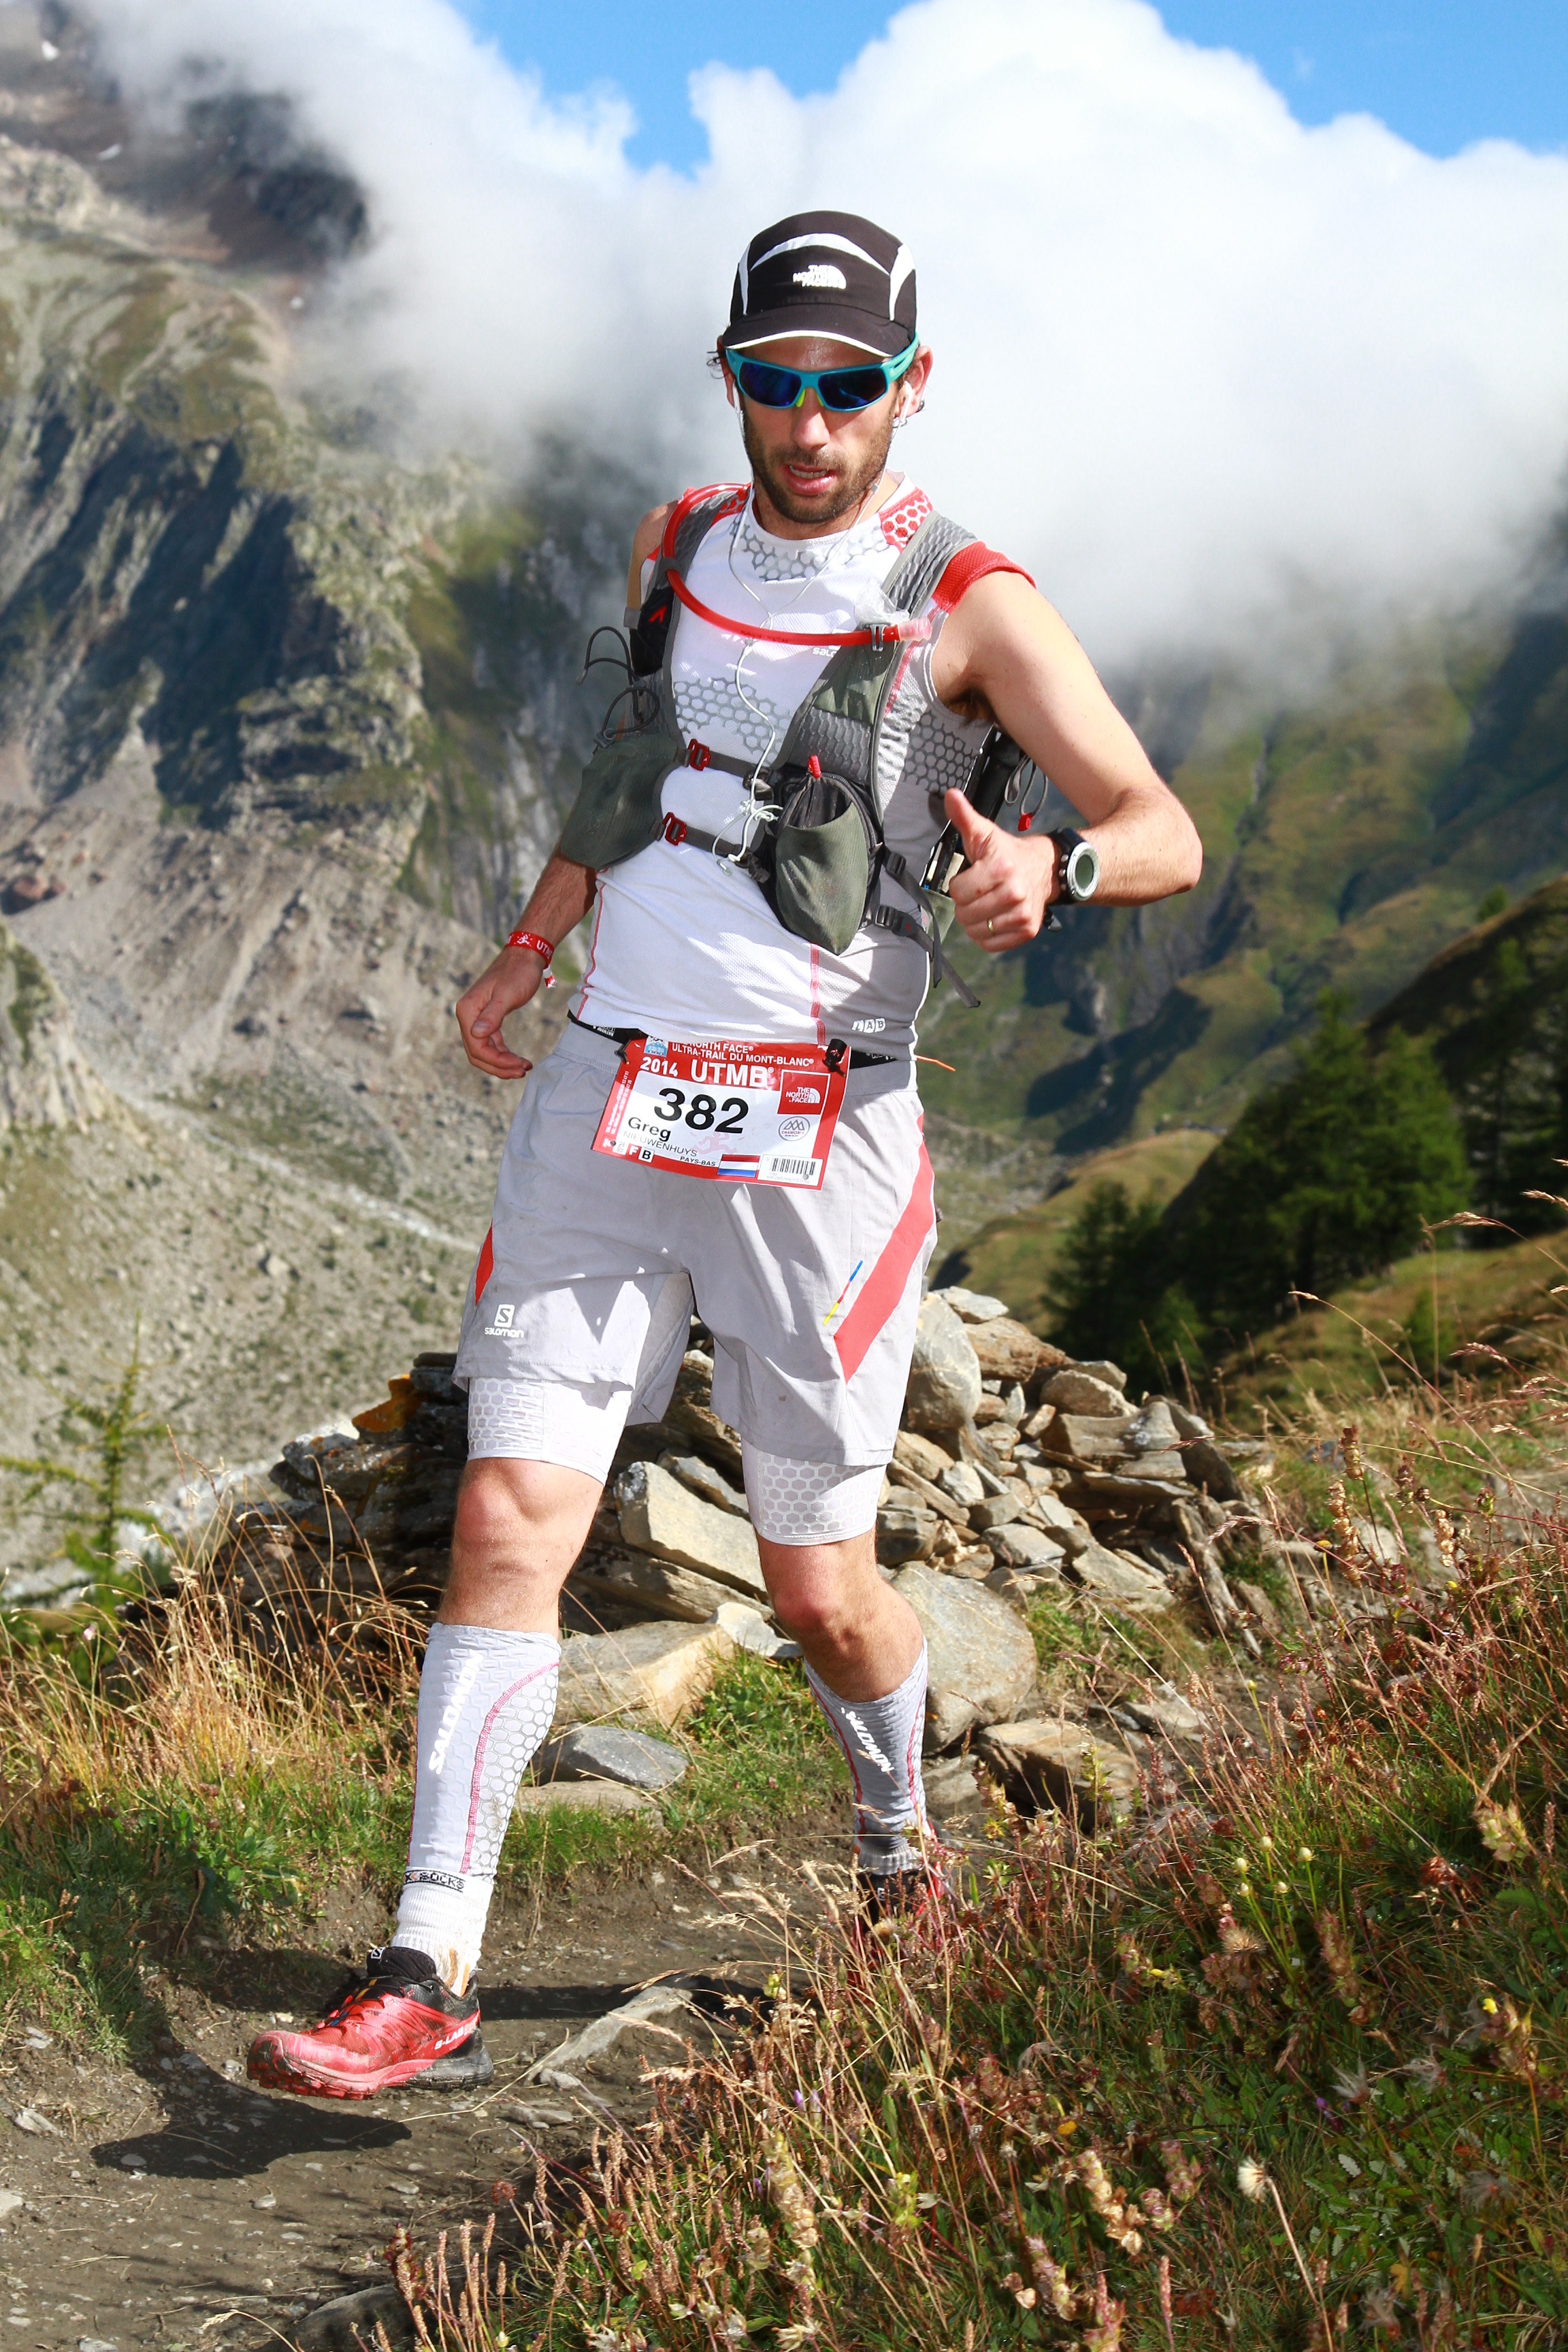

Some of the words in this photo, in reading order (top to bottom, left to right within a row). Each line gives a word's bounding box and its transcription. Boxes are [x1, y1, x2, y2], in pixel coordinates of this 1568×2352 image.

[672, 1043, 728, 1060] ULTRA-TRAIL
[730, 1053, 743, 1062] DU
[640, 1056, 679, 1077] 2014
[654, 1087, 749, 1134] 382
[628, 1117, 671, 1142] Greg
[623, 1130, 698, 1157] NIEUWENHUYS
[629, 1146, 639, 1156] F
[642, 1150, 651, 1160] B
[680, 1156, 716, 1166] PAYS-BAS
[428, 1649, 484, 1774] SALOMON
